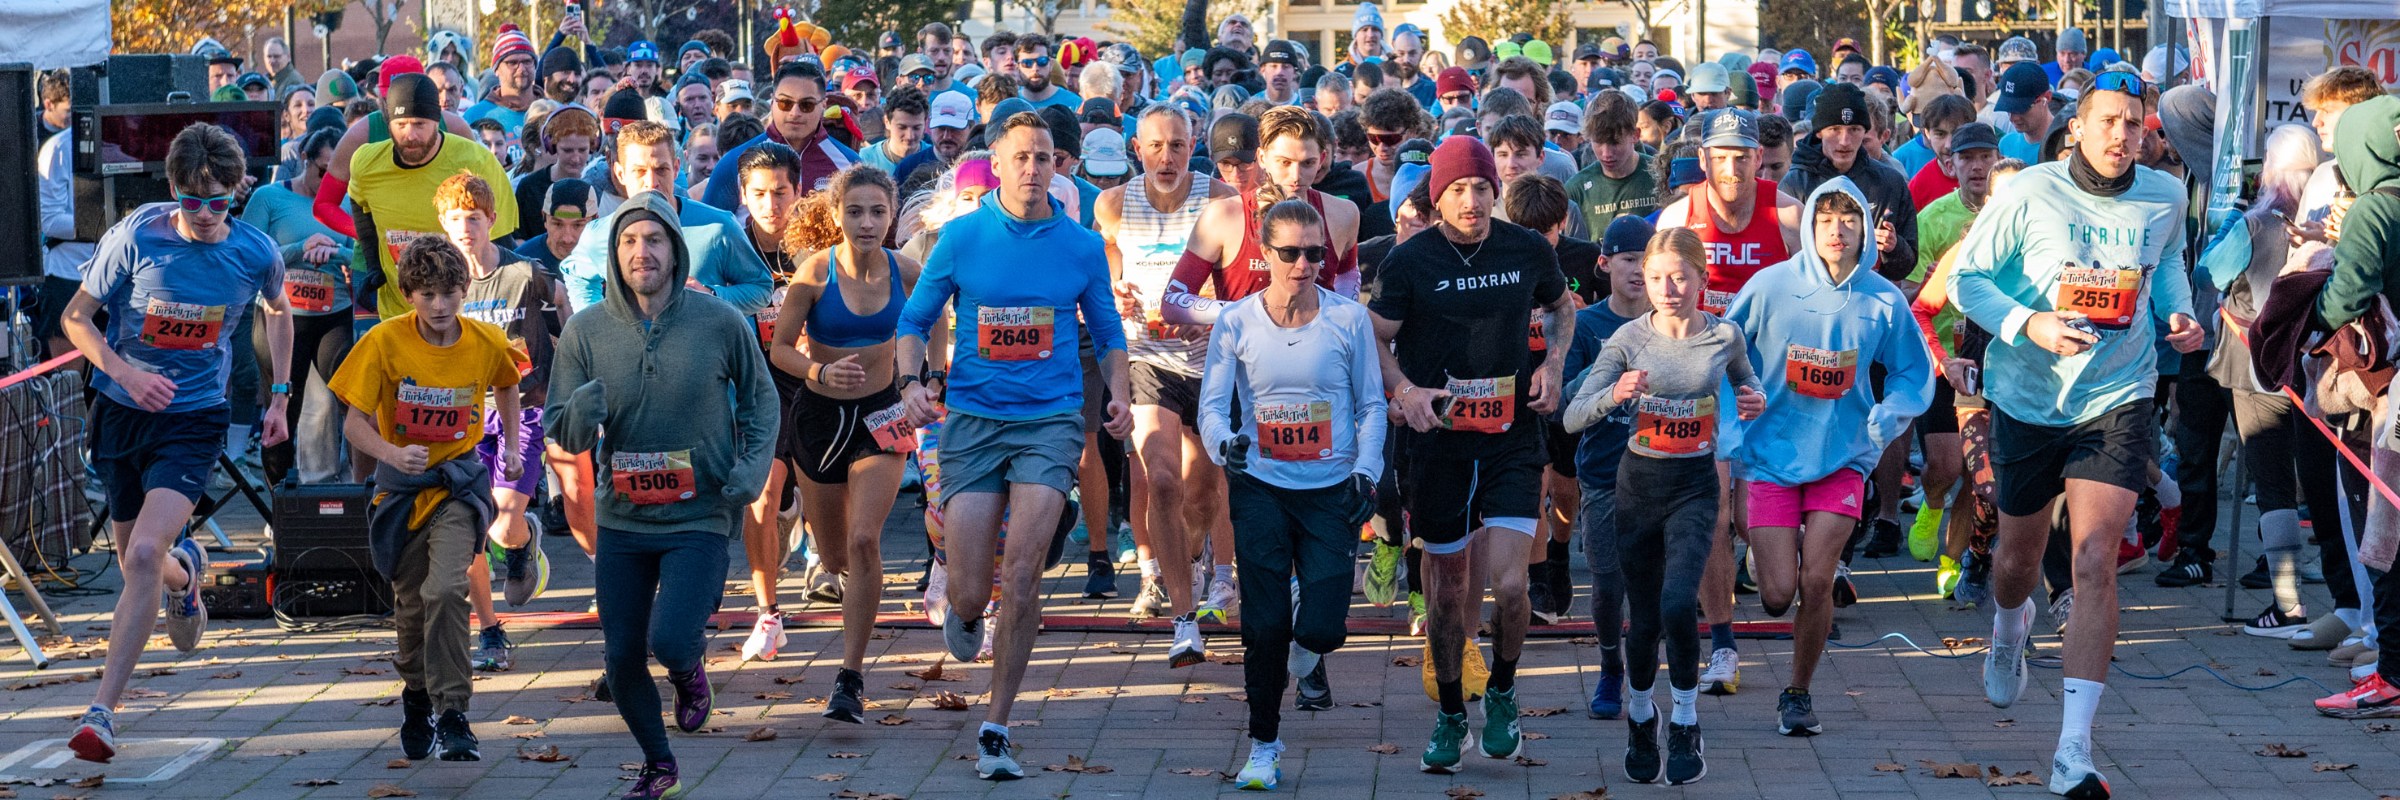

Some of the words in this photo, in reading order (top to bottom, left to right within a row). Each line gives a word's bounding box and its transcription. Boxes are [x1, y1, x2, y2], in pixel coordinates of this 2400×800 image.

[1714, 114, 1747, 128] SRJC
[1594, 203, 1617, 214] MARIA
[1620, 197, 1655, 209] CARRILLO
[391, 235, 412, 244] Turkey
[2068, 224, 2151, 247] THRIVE
[1703, 242, 1760, 265] SRJC
[1457, 271, 1520, 290] BOXRAW
[2066, 273, 2097, 285] Turkey
[2098, 275, 2116, 287] Trot
[292, 284, 326, 301] 2650
[1708, 296, 1732, 305] Turkey
[2071, 290, 2121, 309] 2551
[154, 304, 183, 317] Turkey
[184, 310, 202, 319] Trot
[982, 312, 1011, 323] Turkey
[1012, 313, 1030, 323] Trot
[157, 320, 208, 338] 2473
[990, 328, 1039, 346] 2649
[1792, 350, 1819, 362] Turkey
[1821, 356, 1838, 366] Trot
[1800, 366, 1844, 386] 1690
[403, 391, 433, 403] Turkey
[434, 395, 452, 405] Trot
[1448, 384, 1476, 395] Turkey
[1478, 385, 1495, 396] Trot
[411, 407, 459, 427] 1770
[1260, 410, 1289, 421] Turkey
[1290, 410, 1309, 421] Trot
[1454, 400, 1503, 418] 2138
[1644, 401, 1674, 413] Turkey
[1676, 405, 1694, 416] Trot
[870, 410, 897, 427] Turkey
[887, 421, 914, 440] 165
[1271, 426, 1320, 446] 1814
[1653, 419, 1701, 438] 1489
[616, 458, 645, 470] Turkey
[648, 461, 665, 469] Trot
[627, 473, 679, 491] 1506
